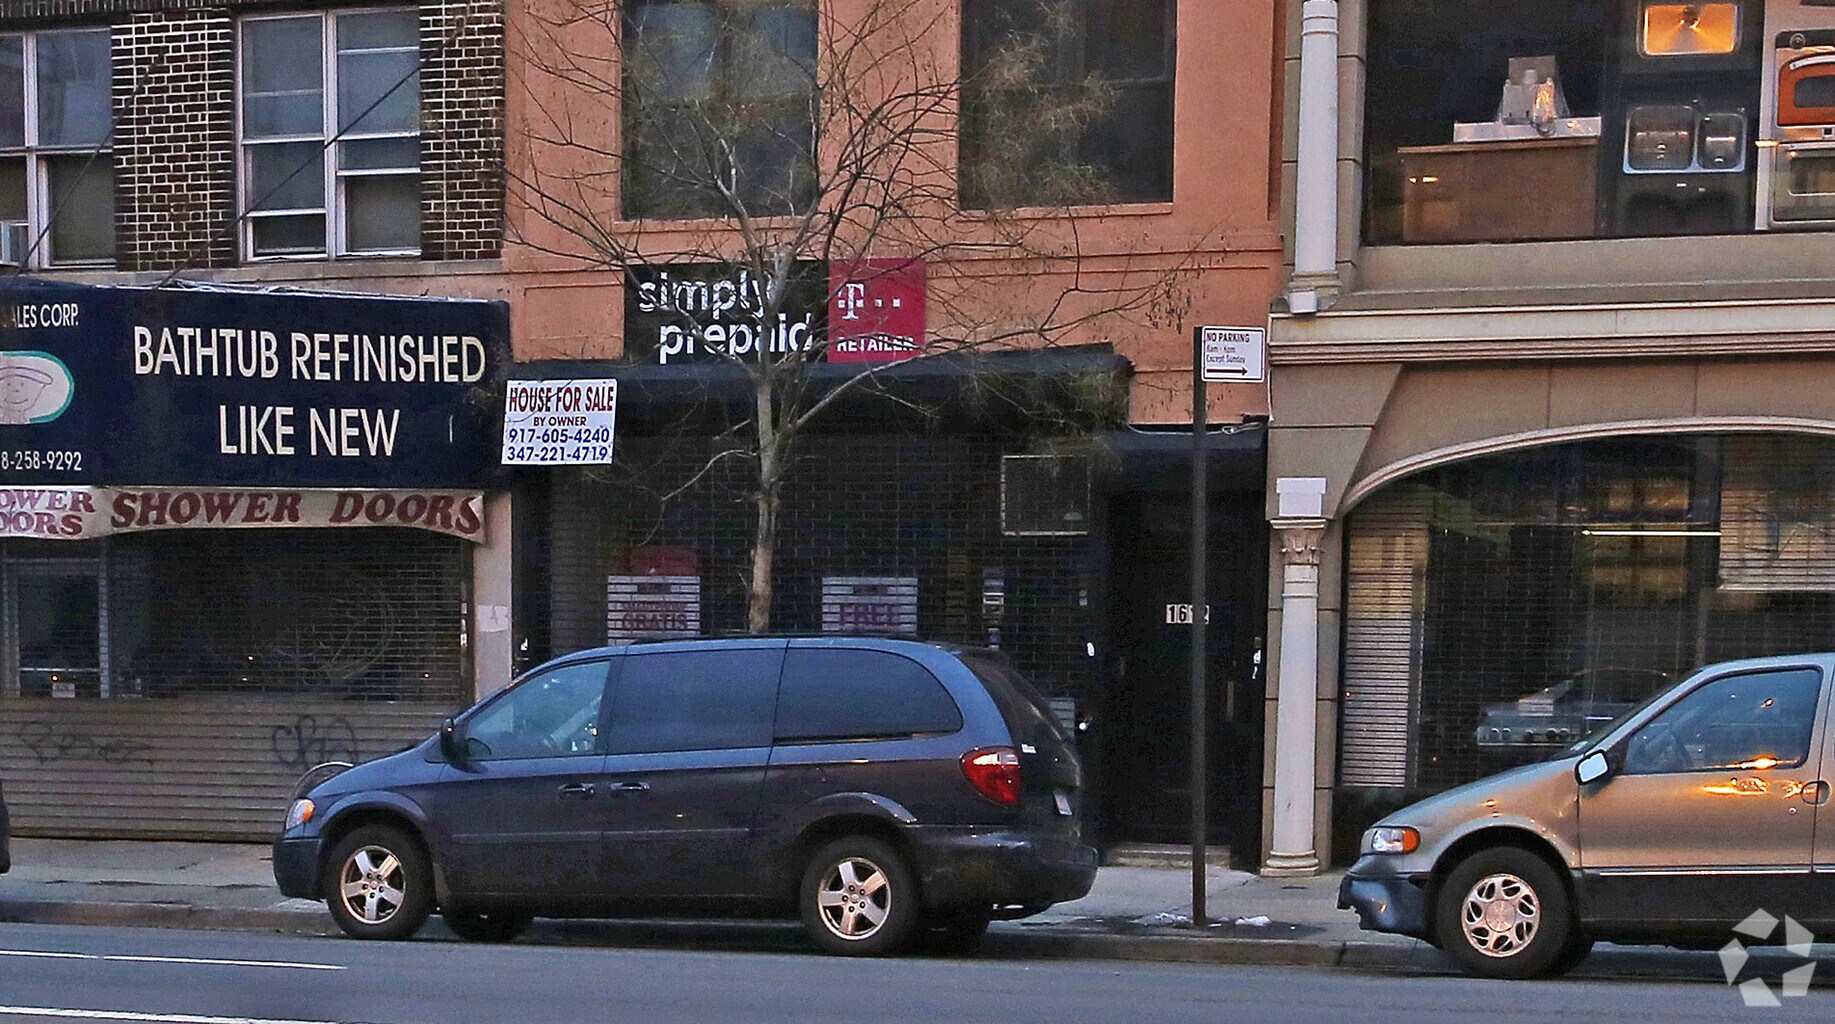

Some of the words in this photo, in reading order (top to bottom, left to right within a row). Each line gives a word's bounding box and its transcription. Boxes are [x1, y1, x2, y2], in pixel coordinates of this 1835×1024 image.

[639, 270, 773, 320] simply
[40, 302, 79, 328] CORP.
[659, 312, 813, 365] prepaid
[1206, 332, 1217, 342] NO
[1218, 332, 1250, 343] PARKING
[133, 326, 279, 379] BATHTUB
[291, 333, 486, 383] REFINISHED
[508, 387, 552, 412] HOUSE
[555, 386, 582, 412] FOR
[584, 386, 614, 412] SALE
[218, 405, 296, 455] LIKE
[309, 408, 400, 456] NEW
[533, 416, 546, 427] BY
[548, 416, 588, 427] OWNER
[508, 428, 611, 444] 917-605-4240
[1, 450, 83, 472] 8-258-9292
[506, 446, 609, 462] 347-221-4719
[110, 491, 302, 528] SHOWER
[329, 491, 481, 535] DOORS
